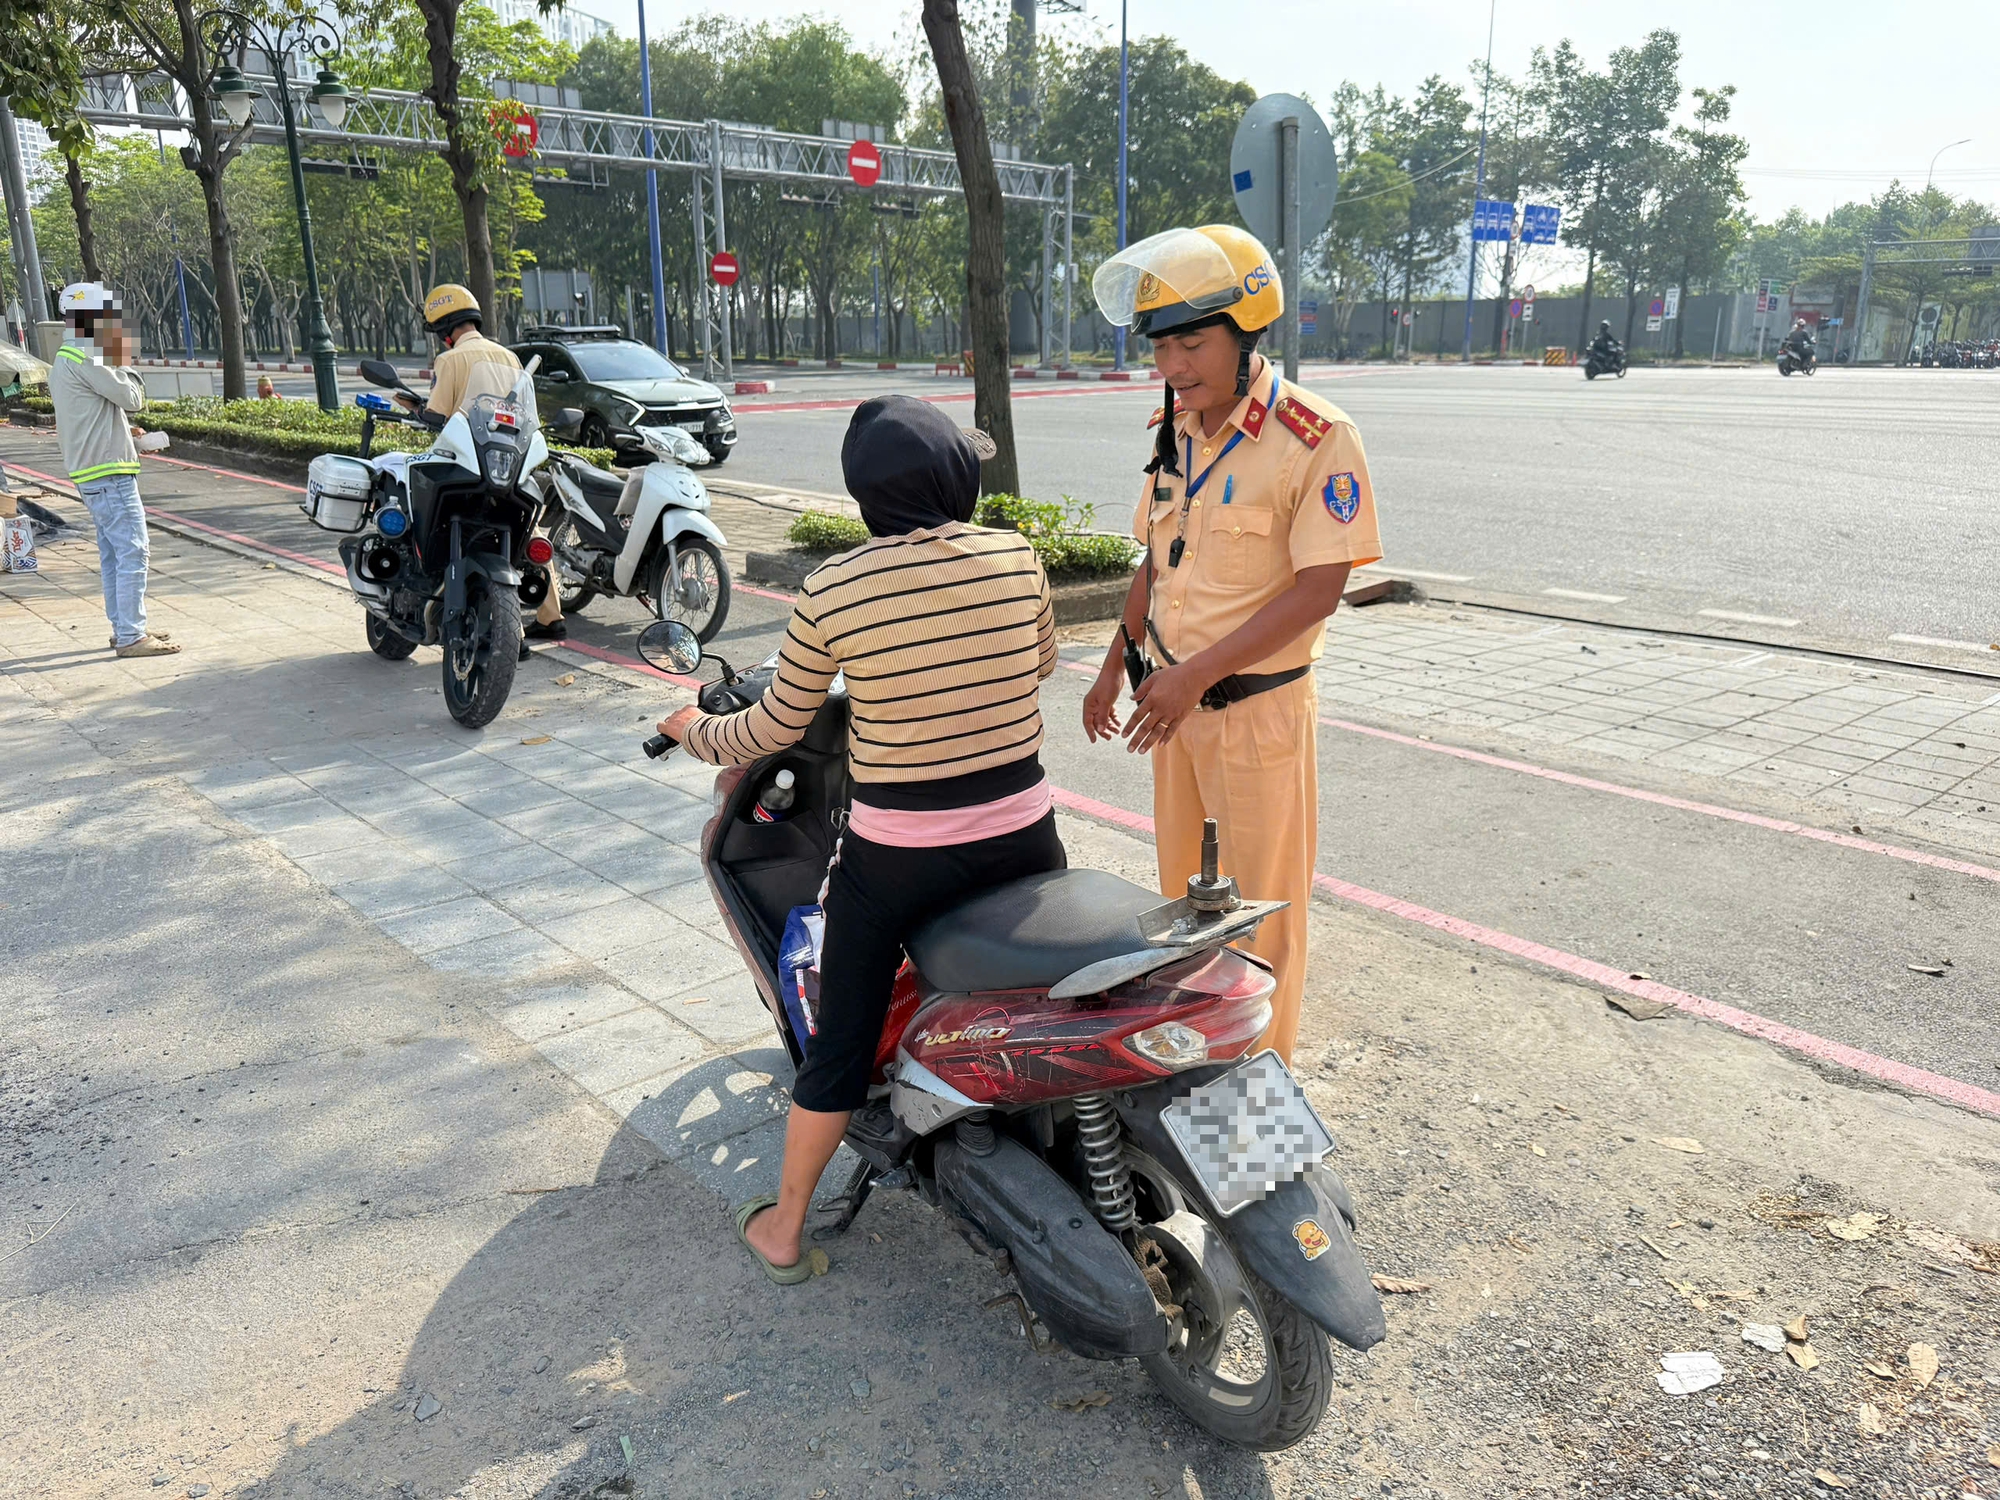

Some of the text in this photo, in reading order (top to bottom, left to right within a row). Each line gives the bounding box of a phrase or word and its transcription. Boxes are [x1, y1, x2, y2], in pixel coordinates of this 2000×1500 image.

[428, 294, 453, 311] CSGT
[406, 453, 434, 464] CSGT
[11, 530, 24, 553] Tiger
